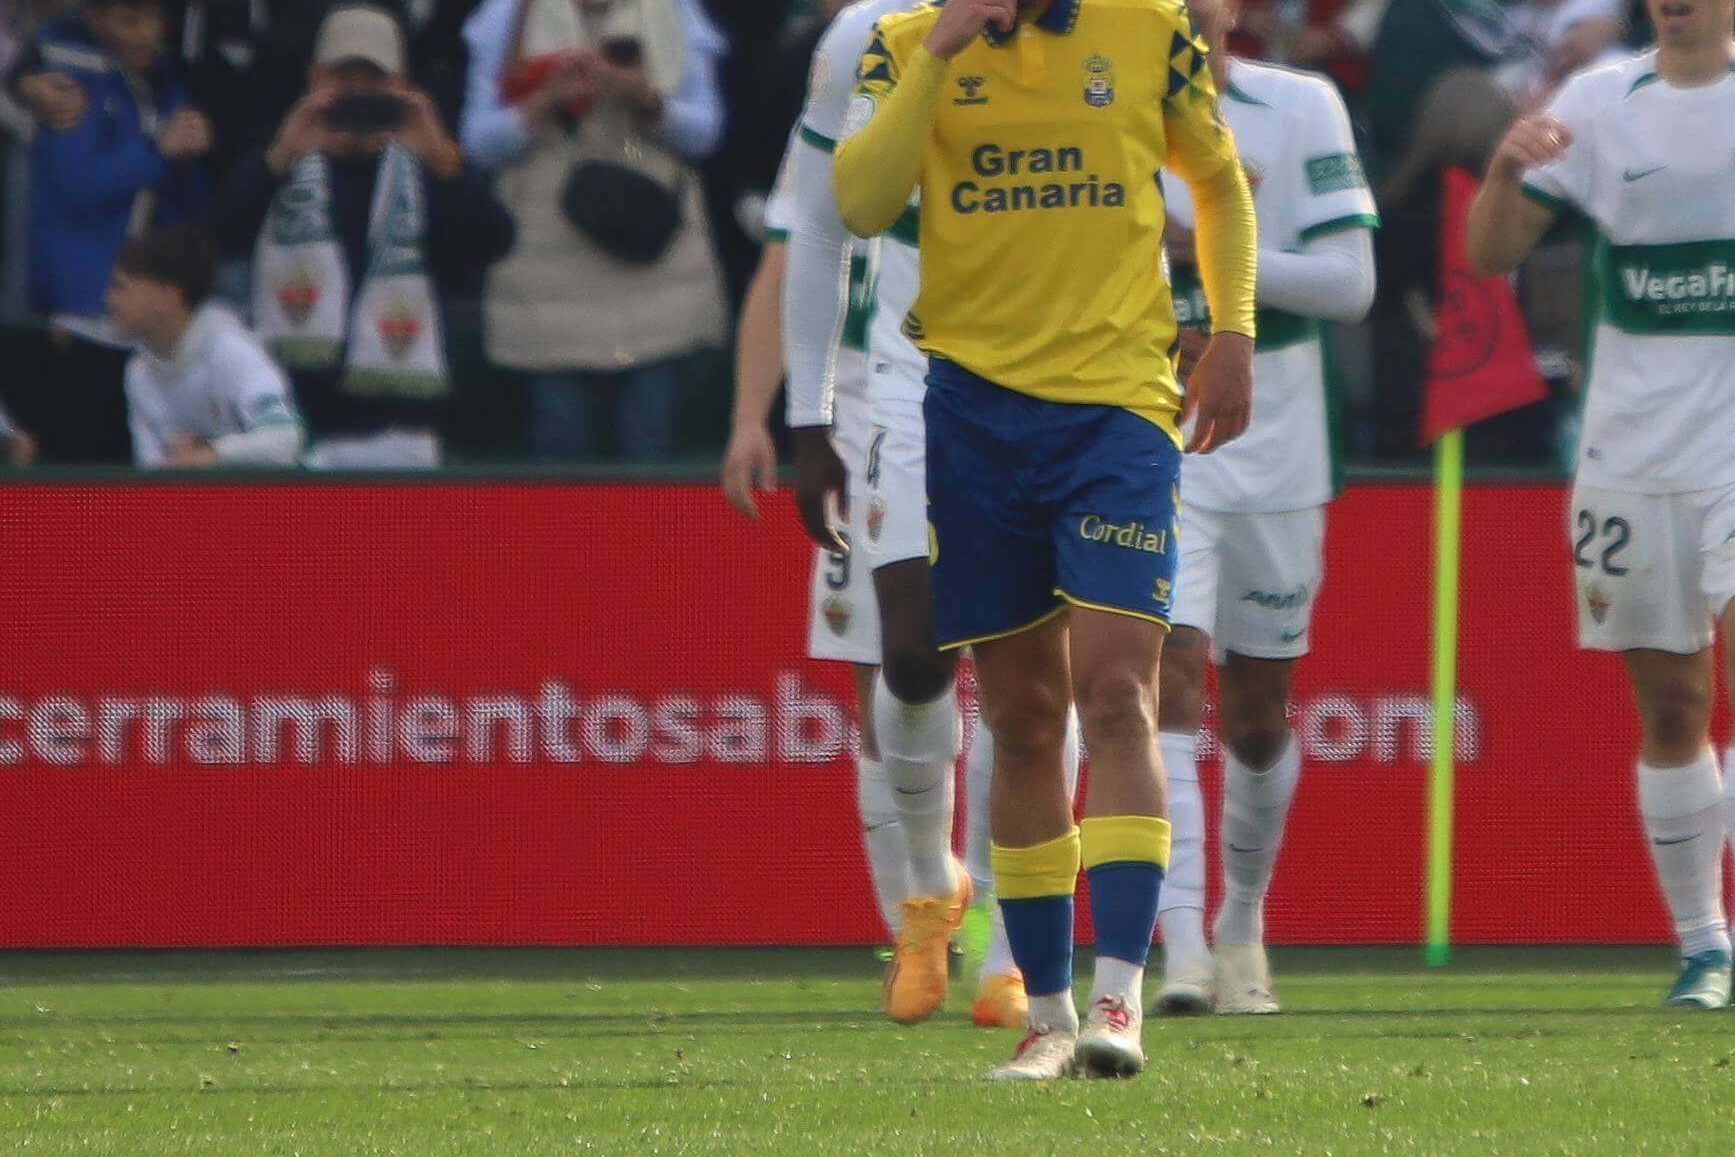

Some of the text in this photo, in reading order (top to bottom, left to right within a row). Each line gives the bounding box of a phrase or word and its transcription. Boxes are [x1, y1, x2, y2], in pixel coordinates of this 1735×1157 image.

[972, 144, 1083, 177] Gran
[951, 174, 1126, 215] Canaria
[1079, 515, 1167, 555] Cordial
[1574, 509, 1632, 576] 22
